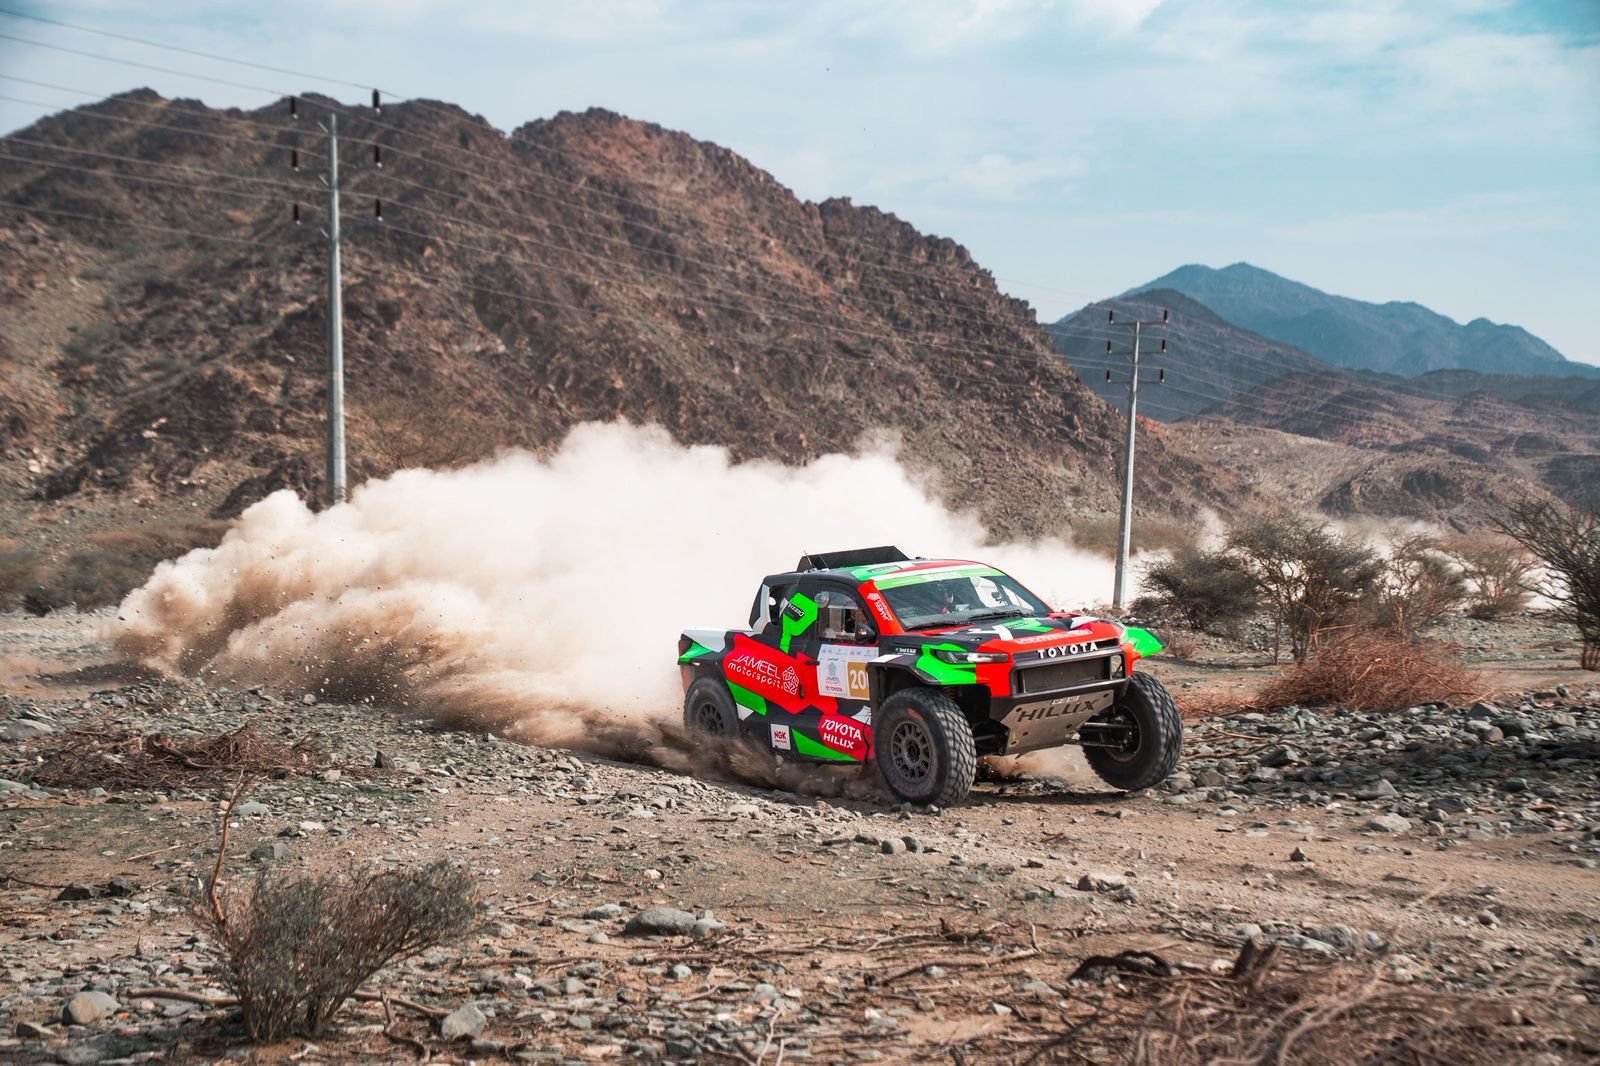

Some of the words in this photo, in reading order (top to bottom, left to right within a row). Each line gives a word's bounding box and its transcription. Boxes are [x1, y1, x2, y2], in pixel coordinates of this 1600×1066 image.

[1037, 641, 1098, 660] TOYOTA
[732, 654, 781, 680] JAMEEL
[849, 669, 869, 690] 20
[1017, 699, 1098, 722] HILUX
[774, 730, 786, 740] NGK
[821, 719, 862, 741] TOYOTA
[823, 732, 855, 750] HILUX
